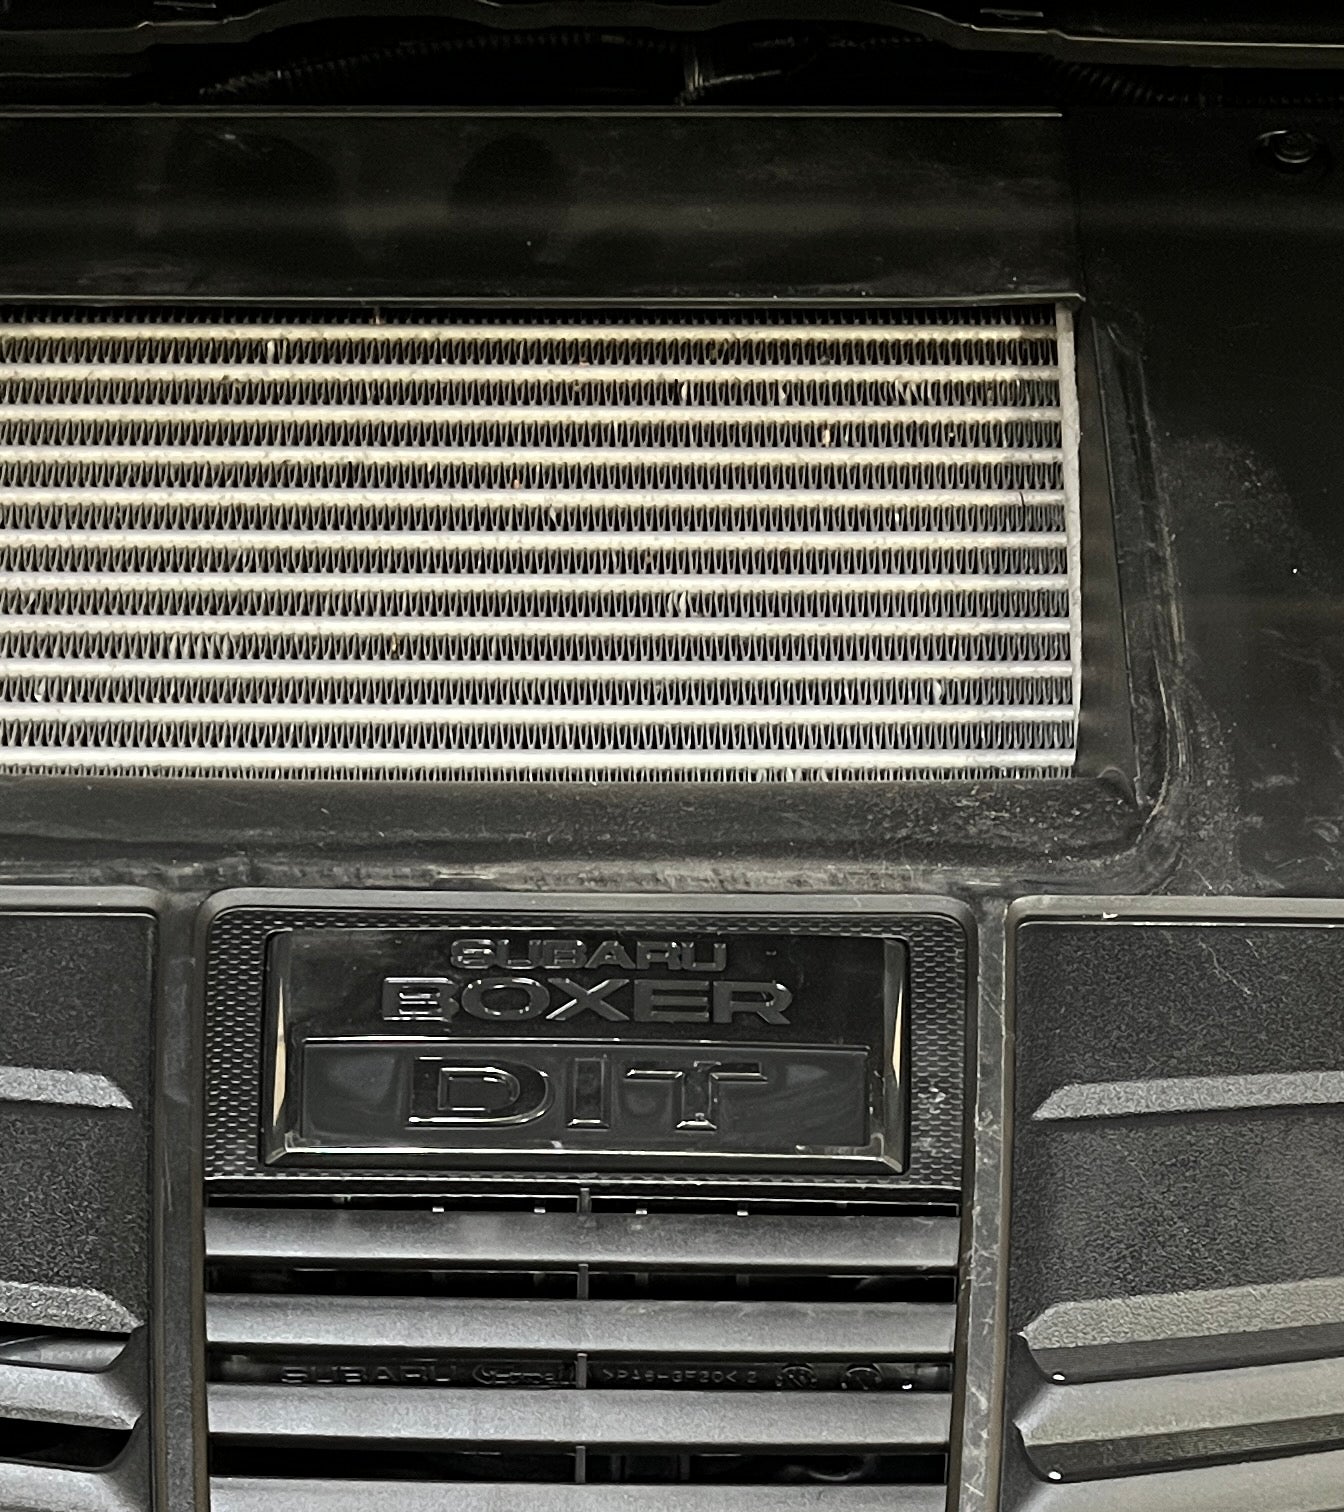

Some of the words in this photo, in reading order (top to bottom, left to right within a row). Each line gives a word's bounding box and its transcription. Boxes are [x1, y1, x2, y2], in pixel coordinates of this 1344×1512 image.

[450, 938, 728, 970] SUBARU
[382, 976, 794, 1025] BOXER
[405, 1054, 769, 1135] DIT
